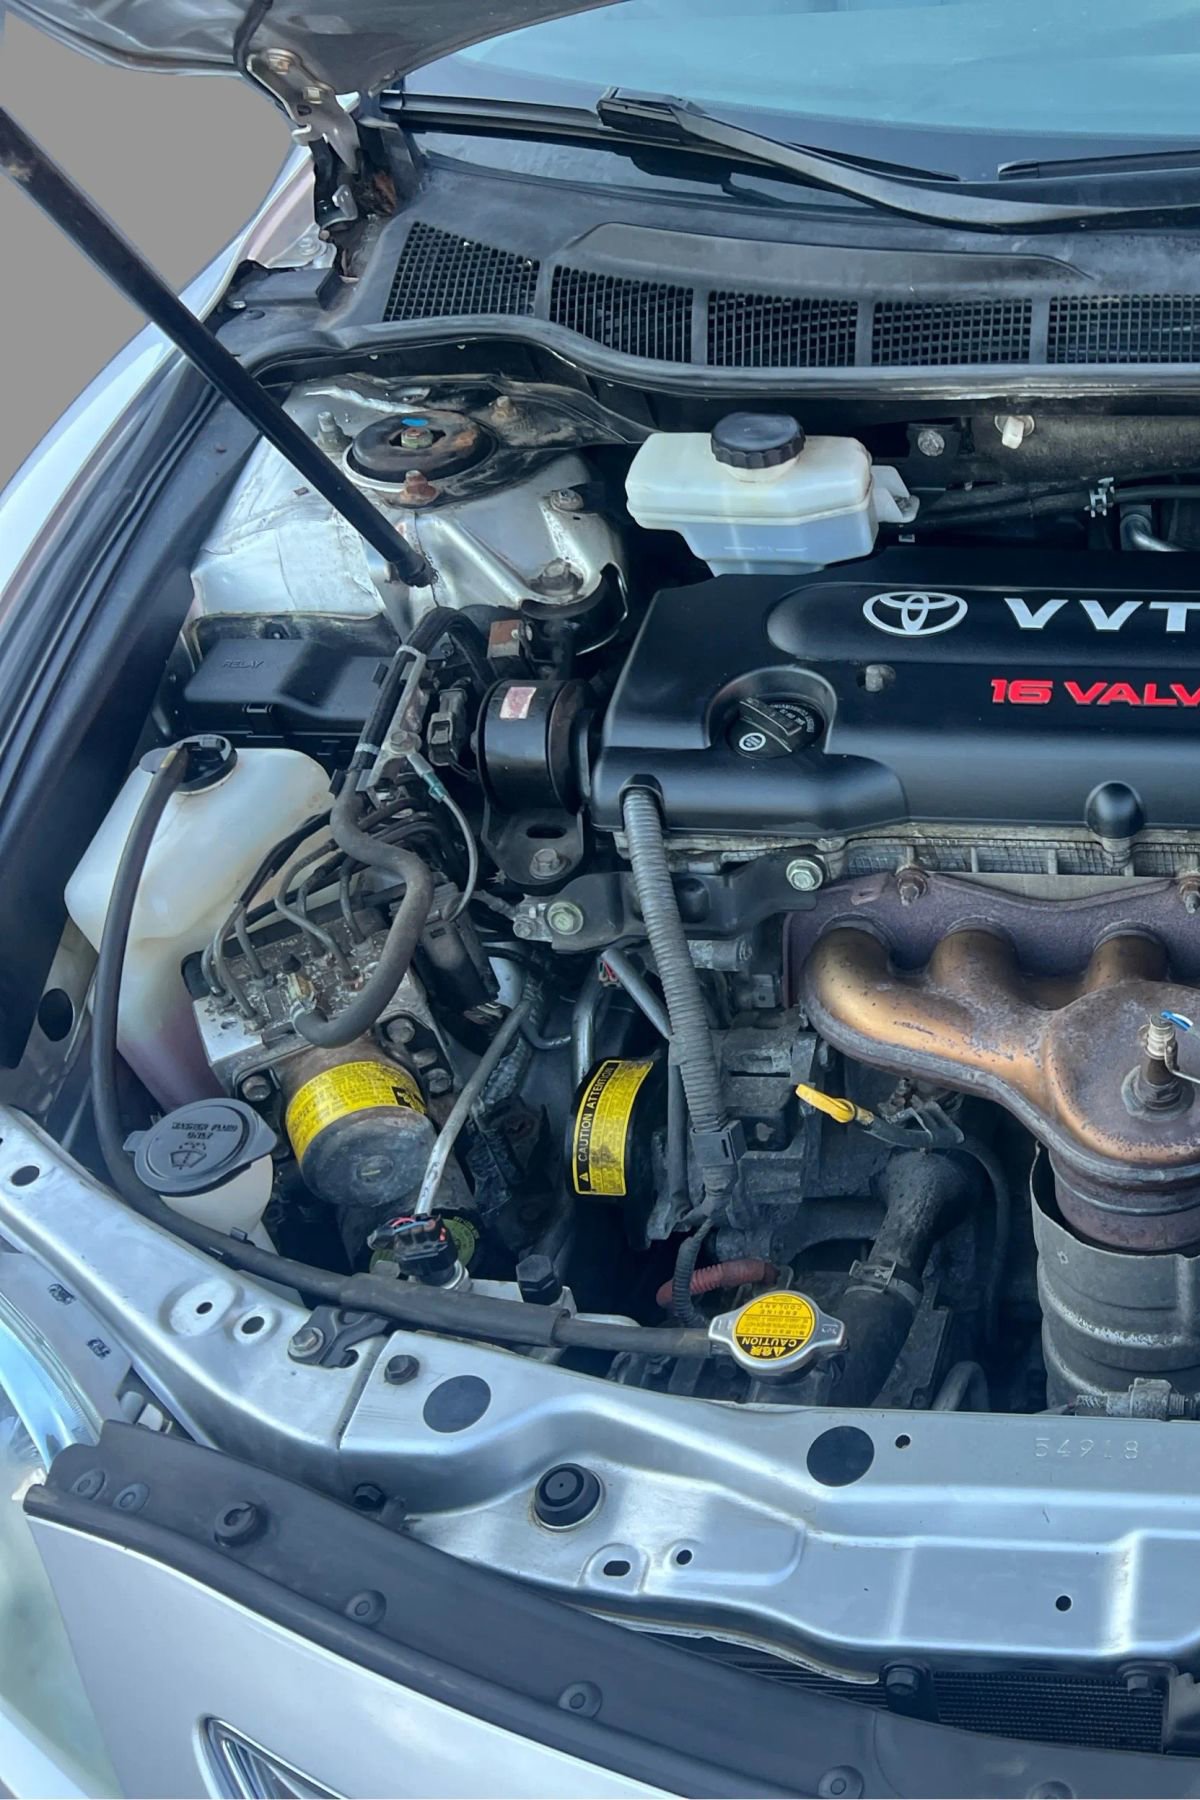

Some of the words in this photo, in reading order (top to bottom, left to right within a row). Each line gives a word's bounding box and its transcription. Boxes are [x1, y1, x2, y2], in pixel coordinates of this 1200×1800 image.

[990, 678, 1054, 704] 16
[577, 1112, 593, 1163] CAUTION
[586, 1066, 615, 1111] ATTENTION
[741, 1337, 797, 1348] CAUTION
